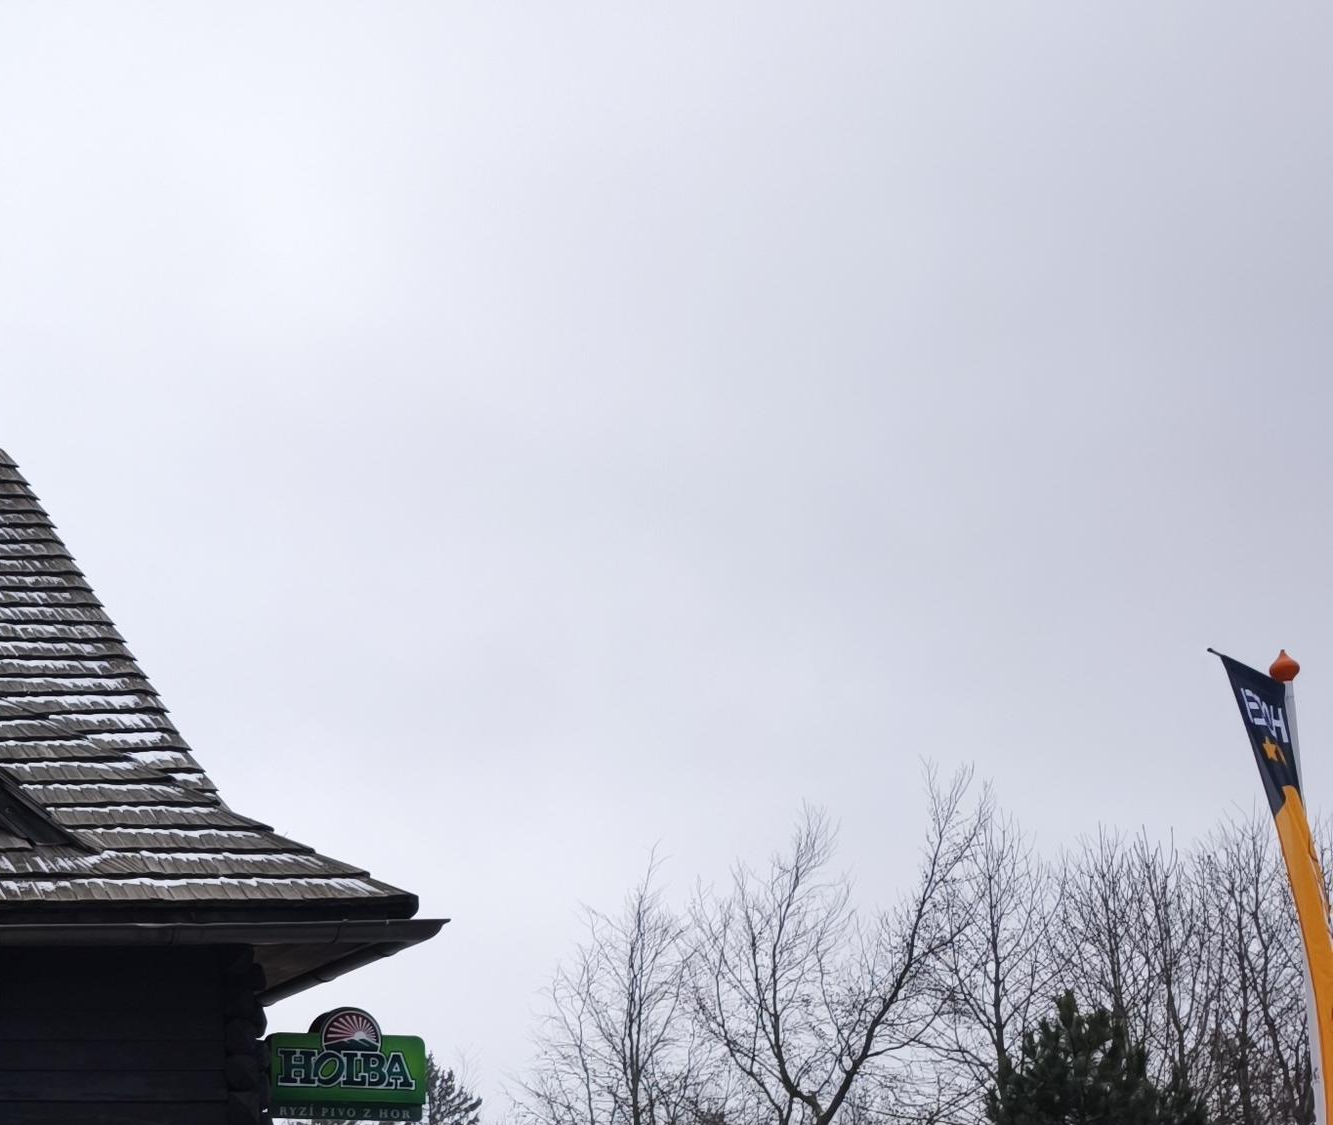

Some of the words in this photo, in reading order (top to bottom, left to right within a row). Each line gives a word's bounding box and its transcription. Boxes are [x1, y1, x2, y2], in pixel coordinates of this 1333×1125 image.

[277, 1048, 416, 1090] HOLBA
[279, 1104, 314, 1117] RYZÍ
[321, 1106, 356, 1118] PIVO
[362, 1107, 372, 1118] Z
[379, 1108, 411, 1119] HOR
